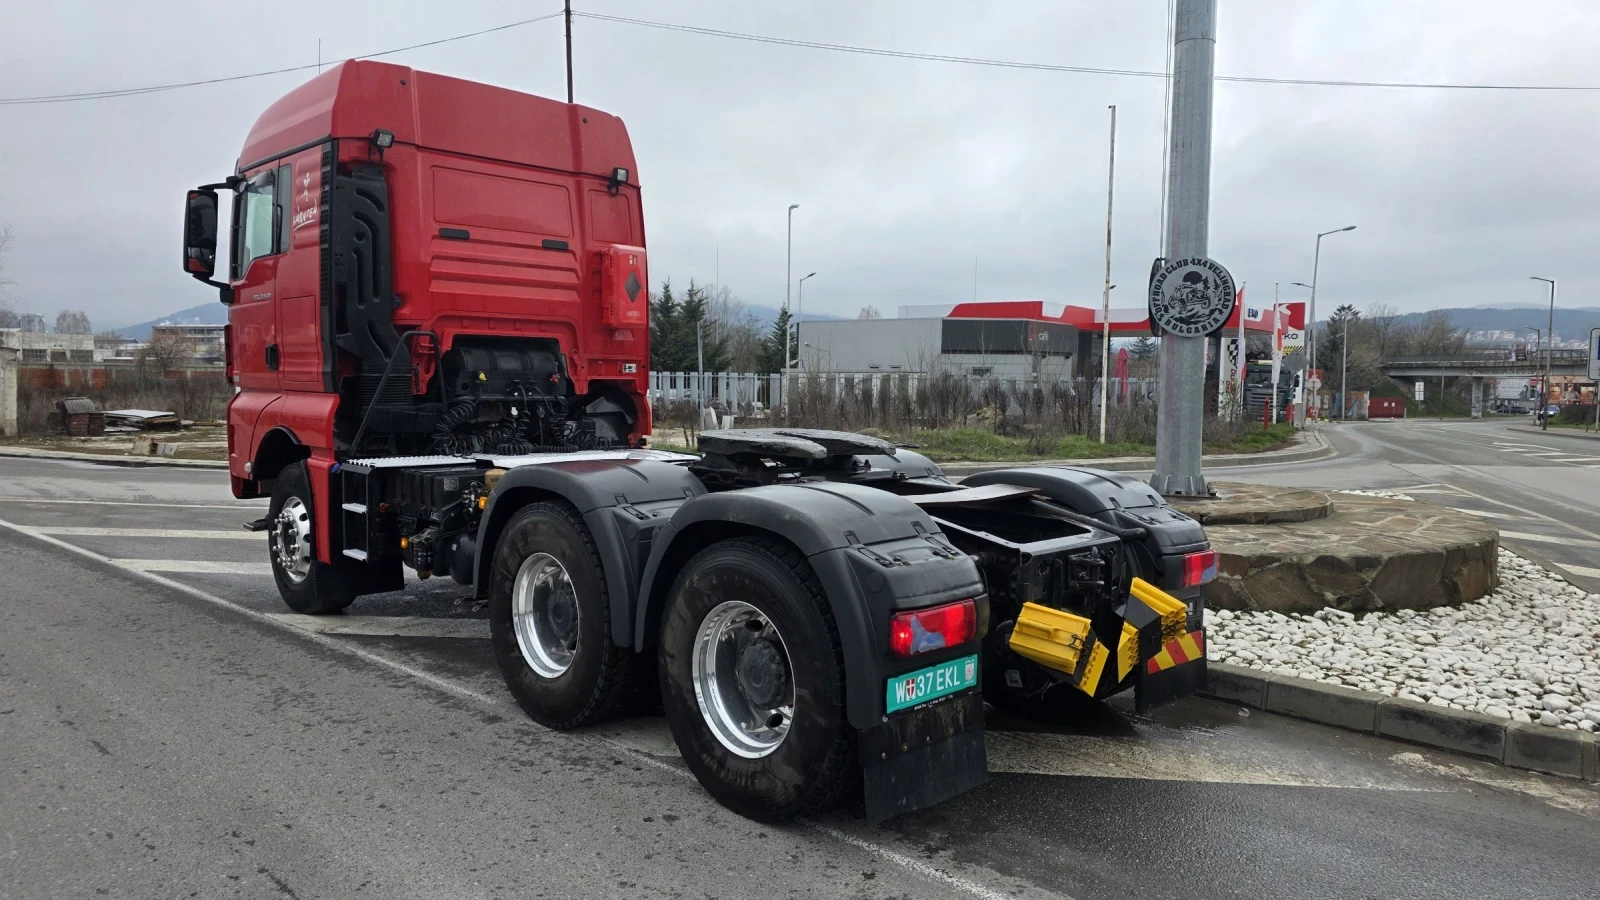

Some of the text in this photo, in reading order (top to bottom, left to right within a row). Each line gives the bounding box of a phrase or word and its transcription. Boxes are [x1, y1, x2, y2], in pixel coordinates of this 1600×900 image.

[1153, 273, 1168, 314] OFFROAD
[1165, 258, 1189, 275] CLUB
[1207, 262, 1232, 310] VELINGRAD
[1164, 317, 1220, 334] BULGARIA
[895, 680, 906, 704] W
[917, 672, 934, 697] 37
[936, 665, 961, 691] EKL
